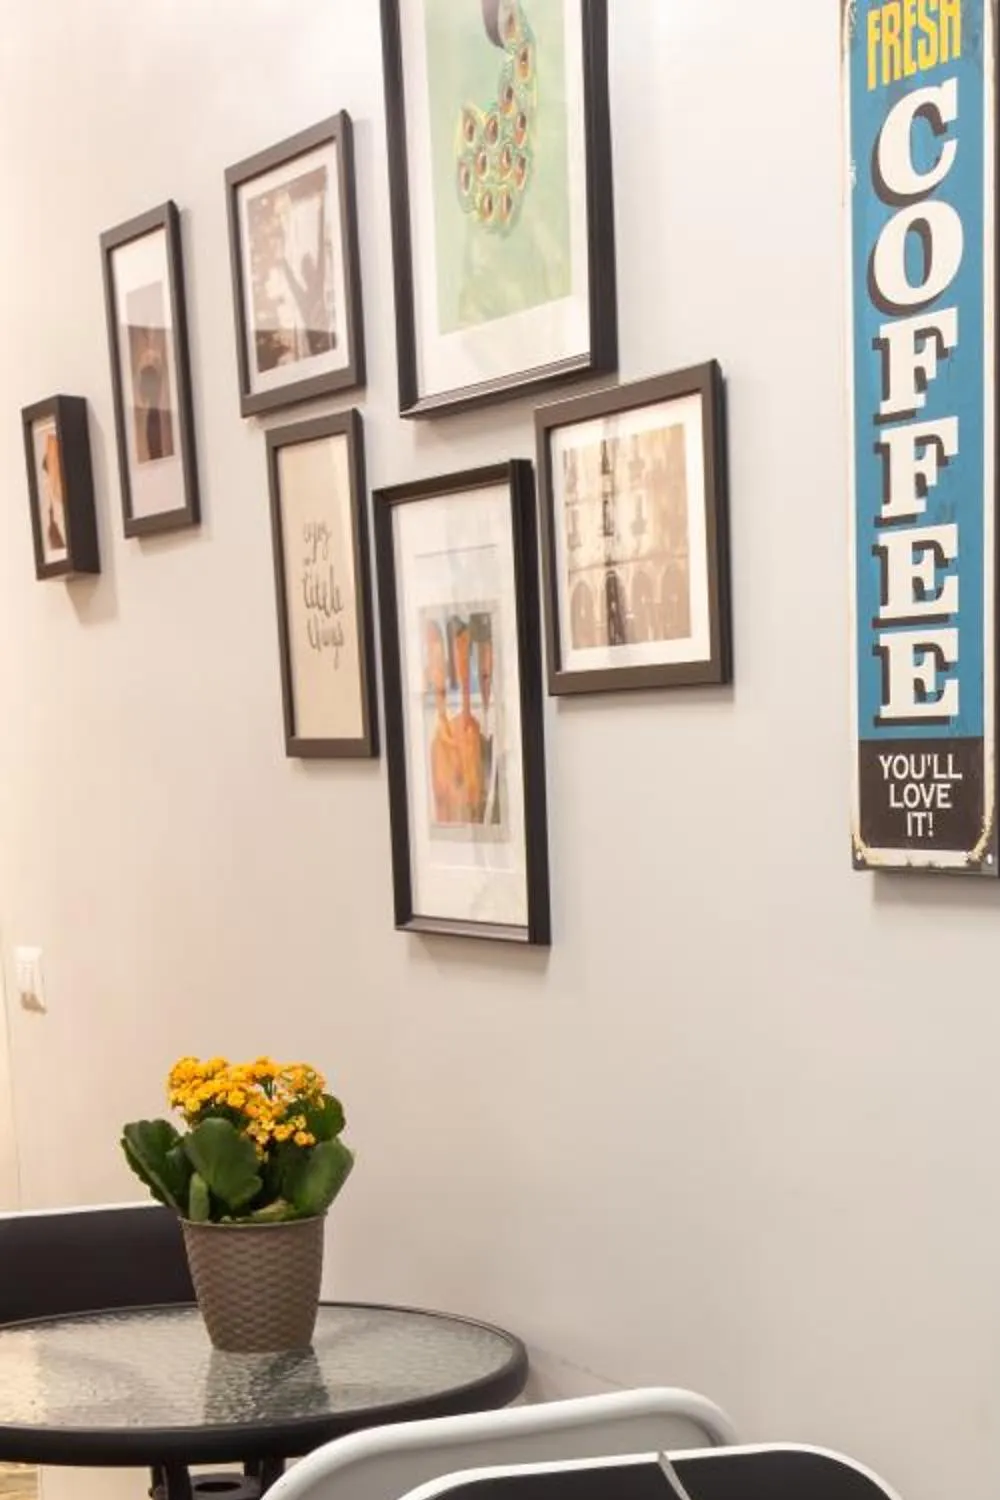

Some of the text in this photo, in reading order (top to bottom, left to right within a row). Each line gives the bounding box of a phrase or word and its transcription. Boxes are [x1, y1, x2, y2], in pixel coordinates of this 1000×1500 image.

[867, 0, 962, 92] FRESH
[870, 77, 964, 722] COFFEE
[879, 753, 963, 779] YOU'LL
[889, 783, 952, 808] LOVE
[907, 811, 933, 837] IT!
